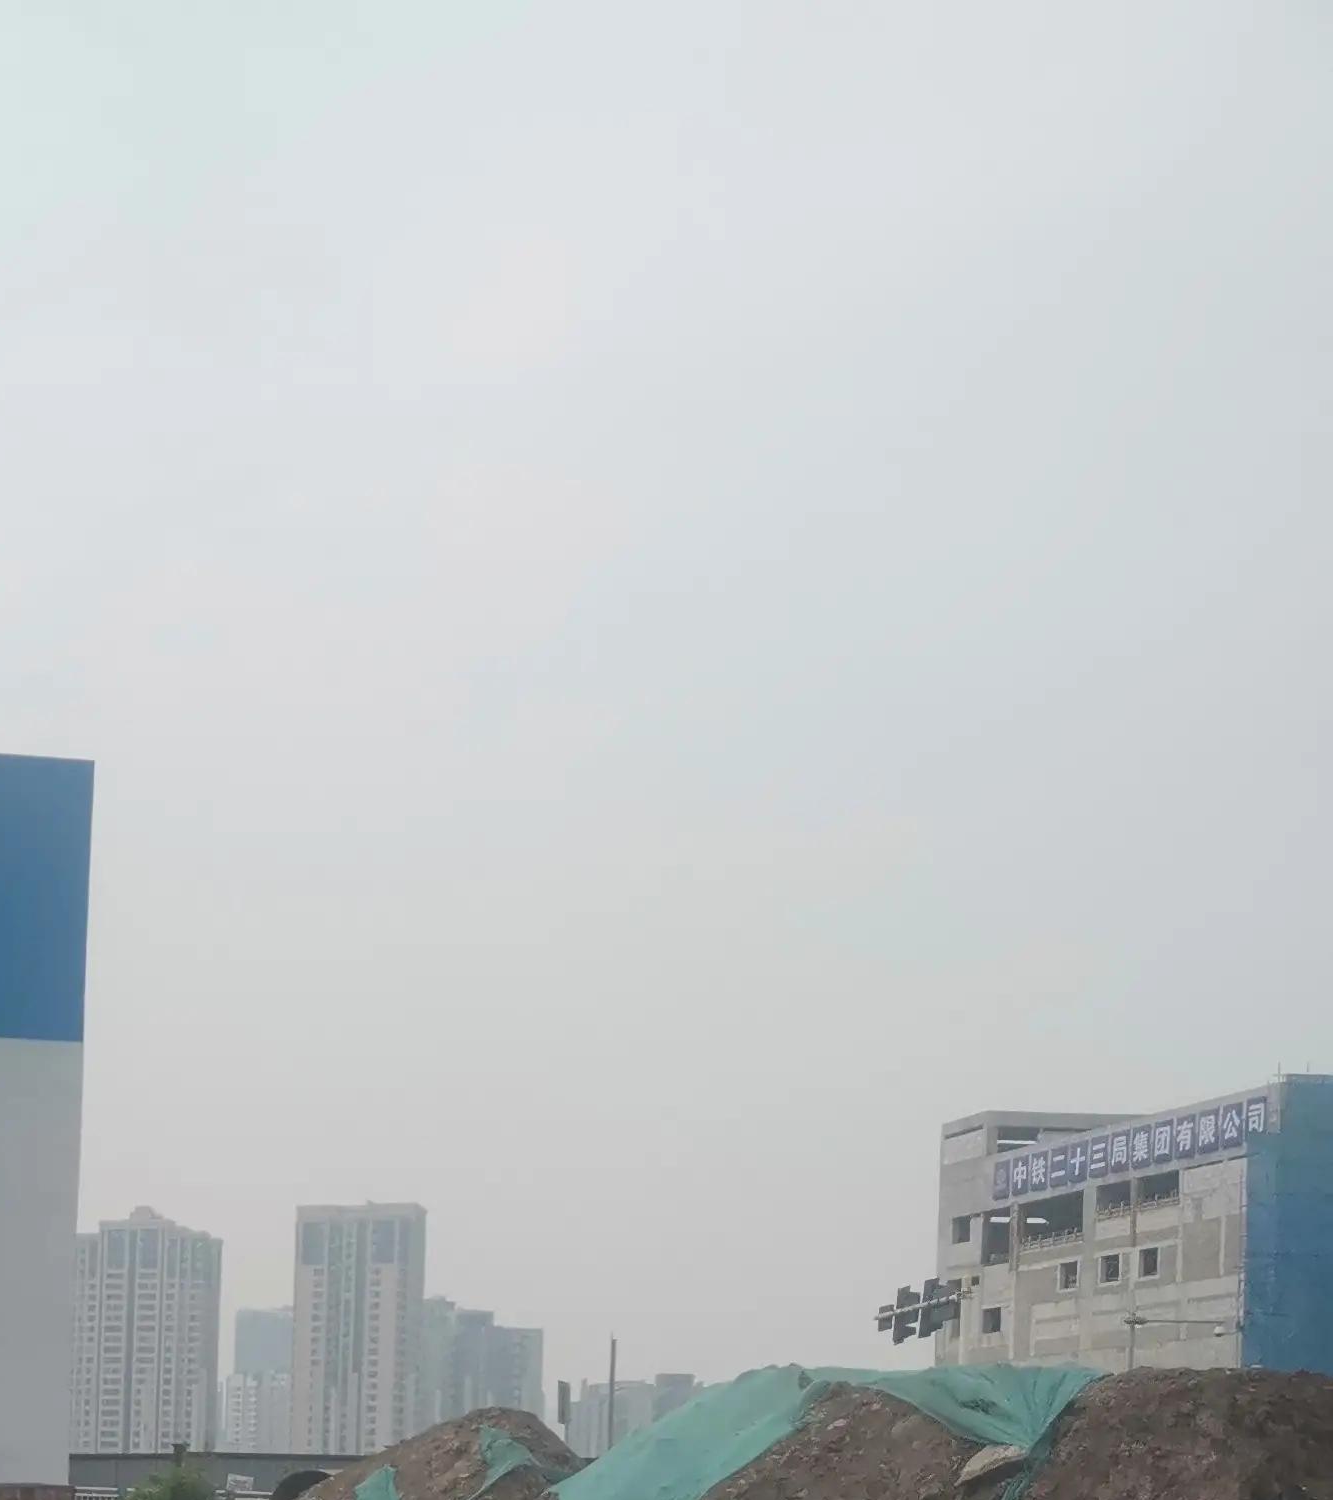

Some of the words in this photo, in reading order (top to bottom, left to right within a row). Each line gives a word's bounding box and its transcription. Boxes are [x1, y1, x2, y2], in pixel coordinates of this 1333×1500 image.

[1012, 1101, 1266, 1189] 中铁二十三局集团有限公司
